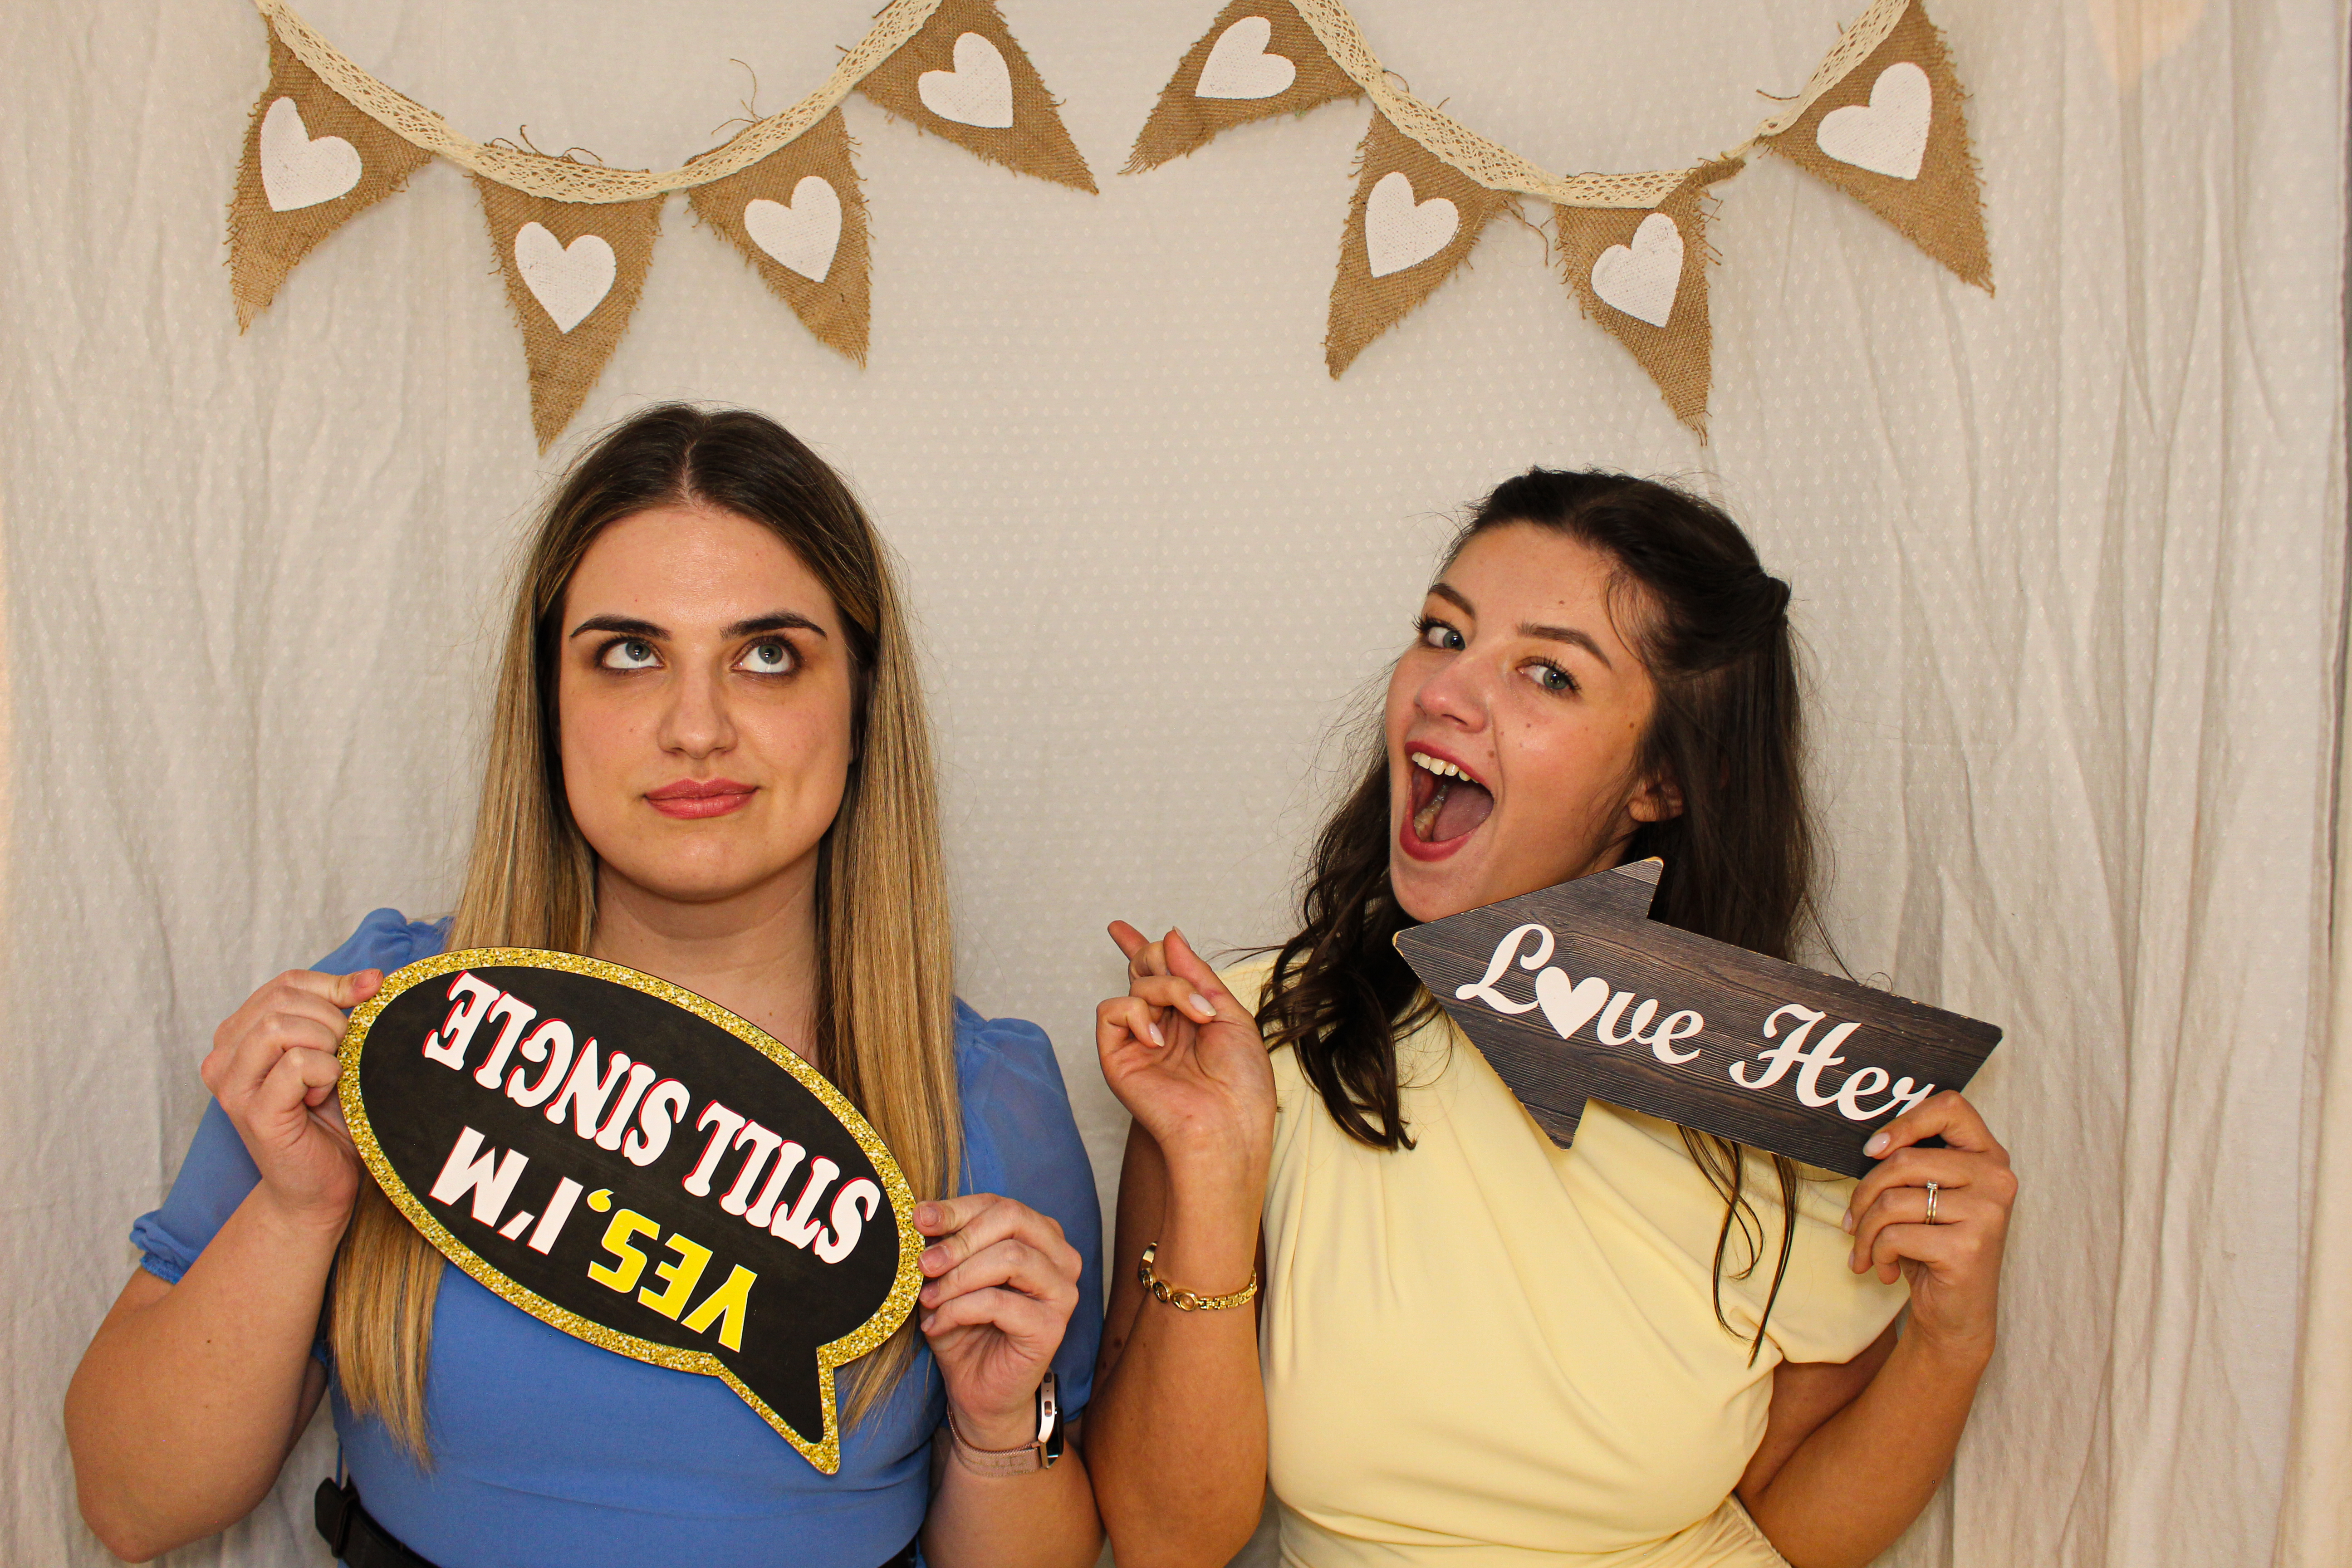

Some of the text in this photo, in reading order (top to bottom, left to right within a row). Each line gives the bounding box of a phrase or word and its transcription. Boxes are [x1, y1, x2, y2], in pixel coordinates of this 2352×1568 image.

[421, 970, 881, 1264] STILL SINGLE
[1729, 1004, 1935, 1121] Her
[428, 1125, 758, 1353] YES, I'M
